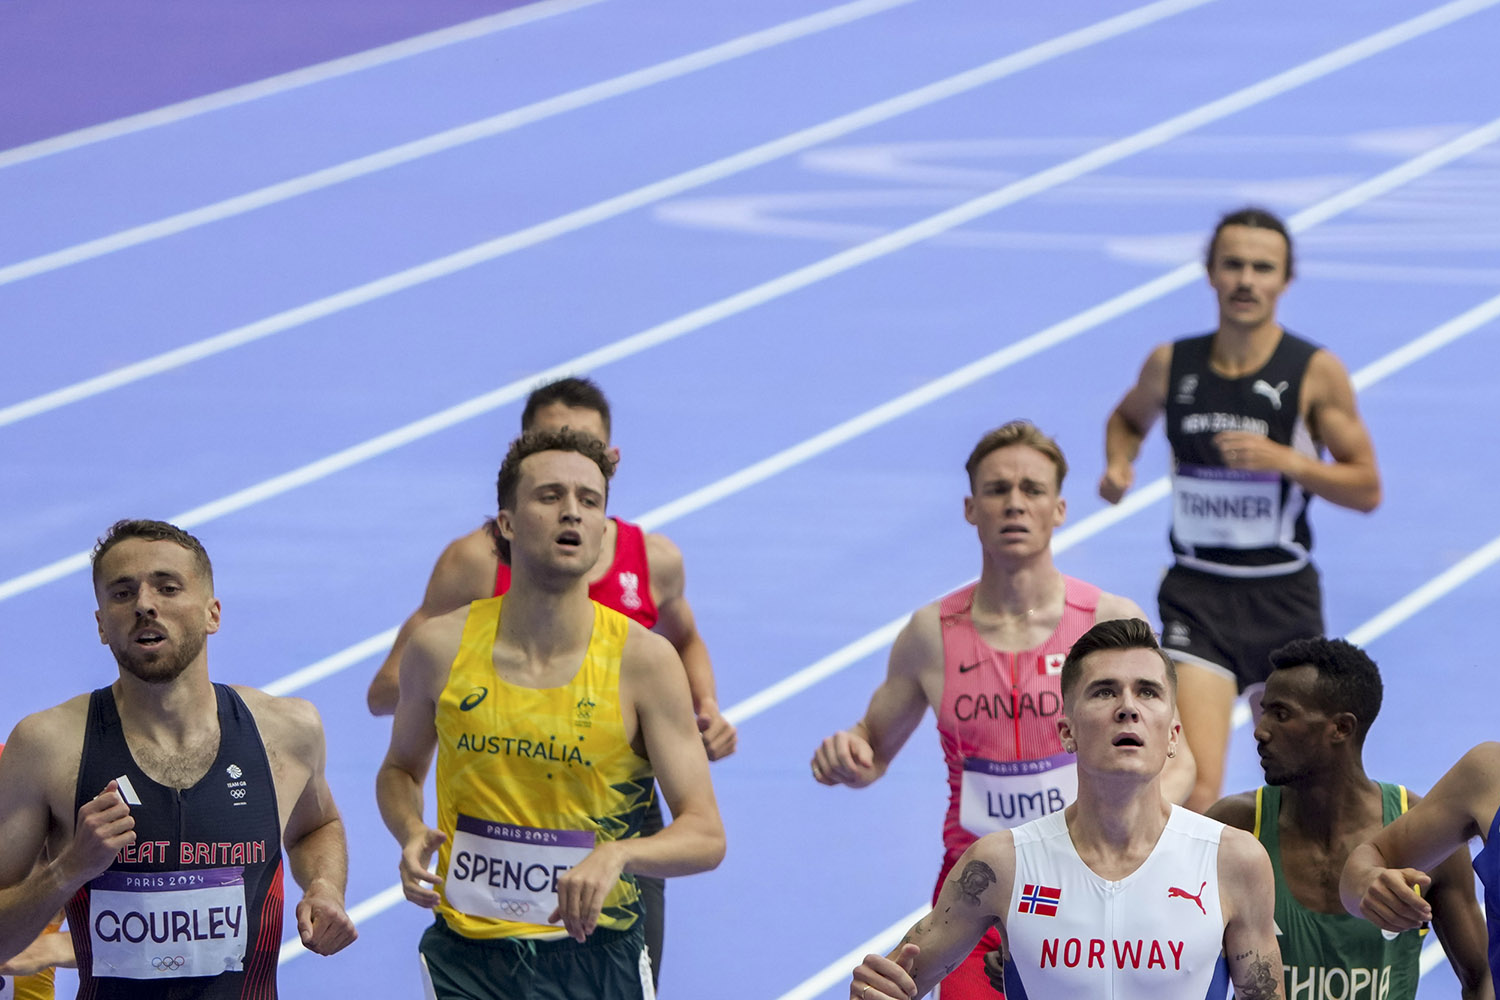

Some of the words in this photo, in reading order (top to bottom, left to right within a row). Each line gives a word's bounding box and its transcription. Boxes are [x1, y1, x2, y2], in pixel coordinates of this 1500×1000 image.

[1179, 491, 1272, 520] TANNER
[955, 691, 1065, 721] CANAD
[457, 733, 583, 766] AUSTRALIA
[987, 788, 1065, 818] LUMB
[487, 825, 521, 839] PARIS
[525, 830, 558, 842] 2024
[180, 840, 266, 864] BRITAIN
[127, 877, 164, 887] PARIS
[169, 875, 204, 886] 2024
[453, 851, 575, 893] SPENCE
[95, 905, 242, 943] GOURLEY
[1040, 937, 1185, 971] NORWAY
